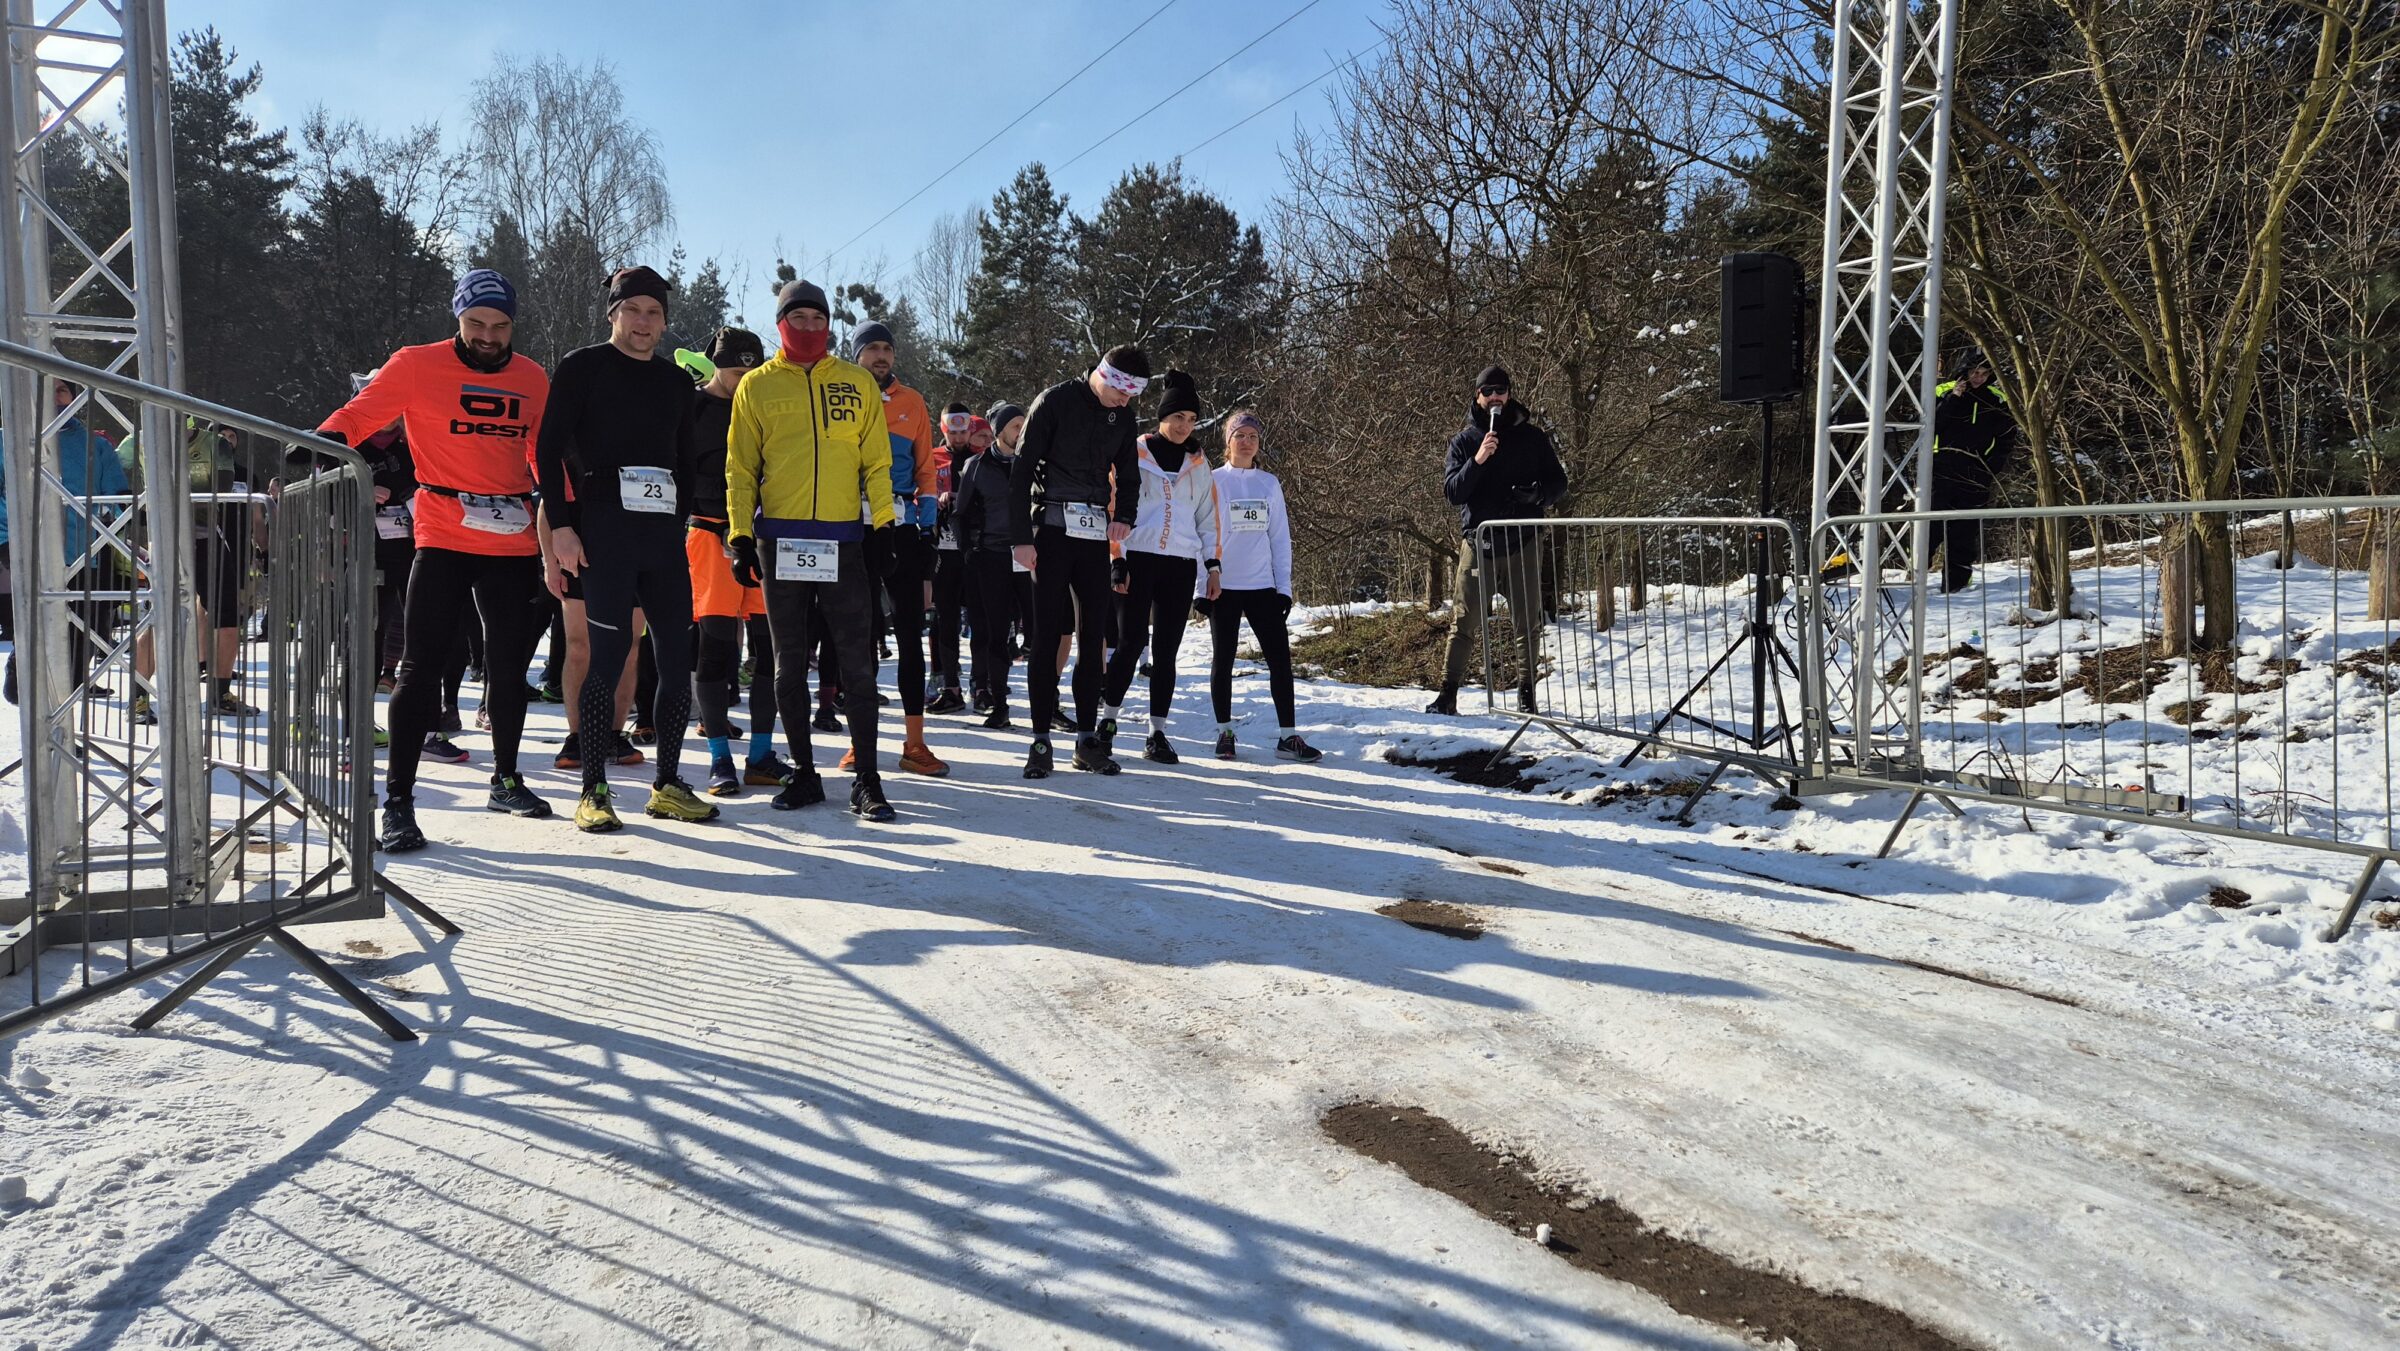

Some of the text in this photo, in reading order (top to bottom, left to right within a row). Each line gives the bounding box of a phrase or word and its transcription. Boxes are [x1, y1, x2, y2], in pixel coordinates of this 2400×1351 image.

[828, 395, 862, 409] om
[831, 408, 856, 423] on
[450, 418, 529, 438] best
[643, 483, 663, 499] 23
[491, 508, 504, 520] 2
[1243, 510, 1258, 520] 48
[393, 516, 408, 527] 43
[1079, 516, 1095, 528] 61
[1159, 503, 1172, 551] ARMOUR
[796, 553, 817, 568] 53
